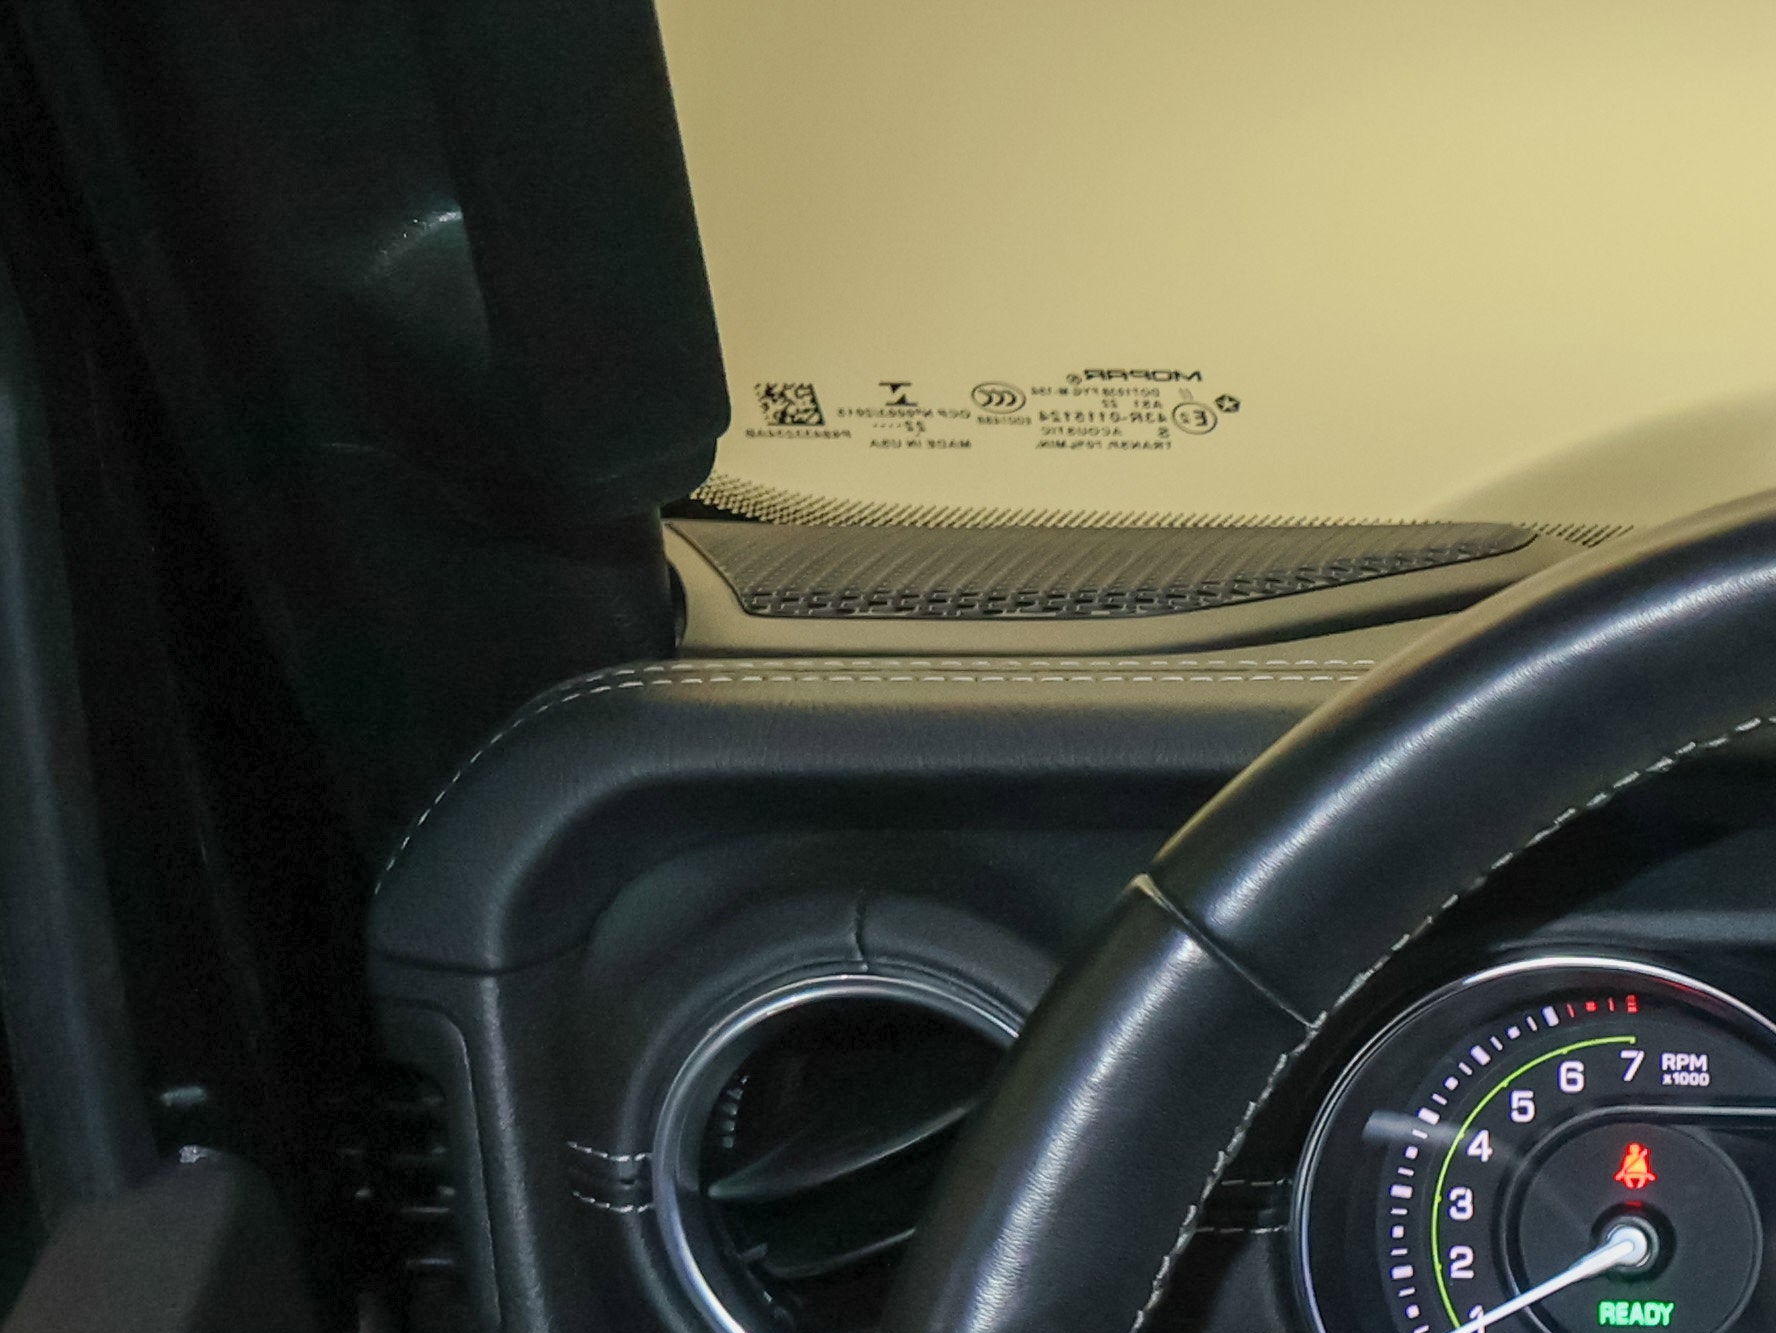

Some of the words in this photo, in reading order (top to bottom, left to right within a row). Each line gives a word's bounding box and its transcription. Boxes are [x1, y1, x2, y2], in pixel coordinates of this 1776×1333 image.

[1559, 1062, 1584, 1093] 6
[1619, 1051, 1644, 1081] 7
[1661, 1054, 1708, 1072] RPM
[1662, 1073, 1709, 1086] x1000
[1510, 1091, 1535, 1122] 5
[1467, 1131, 1493, 1160] 4
[1449, 1187, 1474, 1219] 3
[1449, 1247, 1474, 1279] 2
[1600, 1302, 1674, 1326] READY
